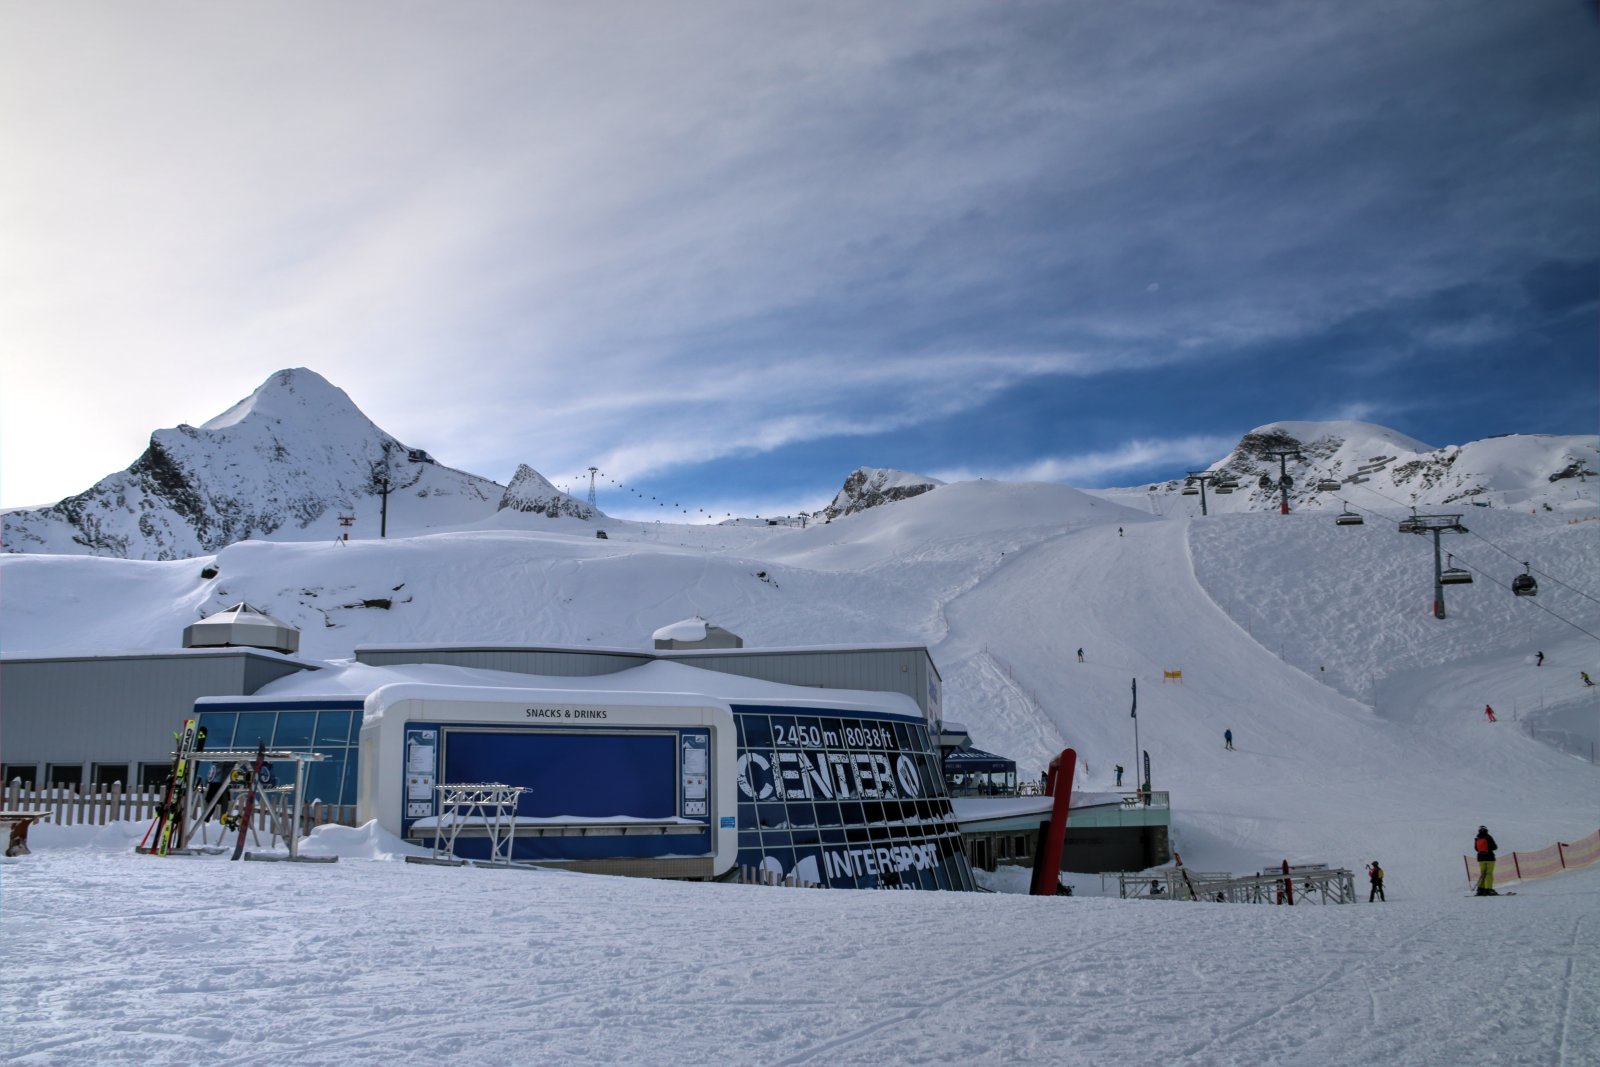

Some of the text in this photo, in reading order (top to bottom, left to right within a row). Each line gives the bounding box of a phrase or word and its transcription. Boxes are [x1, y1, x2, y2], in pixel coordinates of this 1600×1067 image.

[526, 708, 607, 719] SNACKS & DRINKS
[181, 728, 193, 760] HEAD
[774, 725, 821, 746] 2450
[823, 731, 839, 746] m
[846, 727, 881, 747] 8038
[737, 752, 897, 800] CENTER
[825, 843, 939, 879] INTERSPORT
